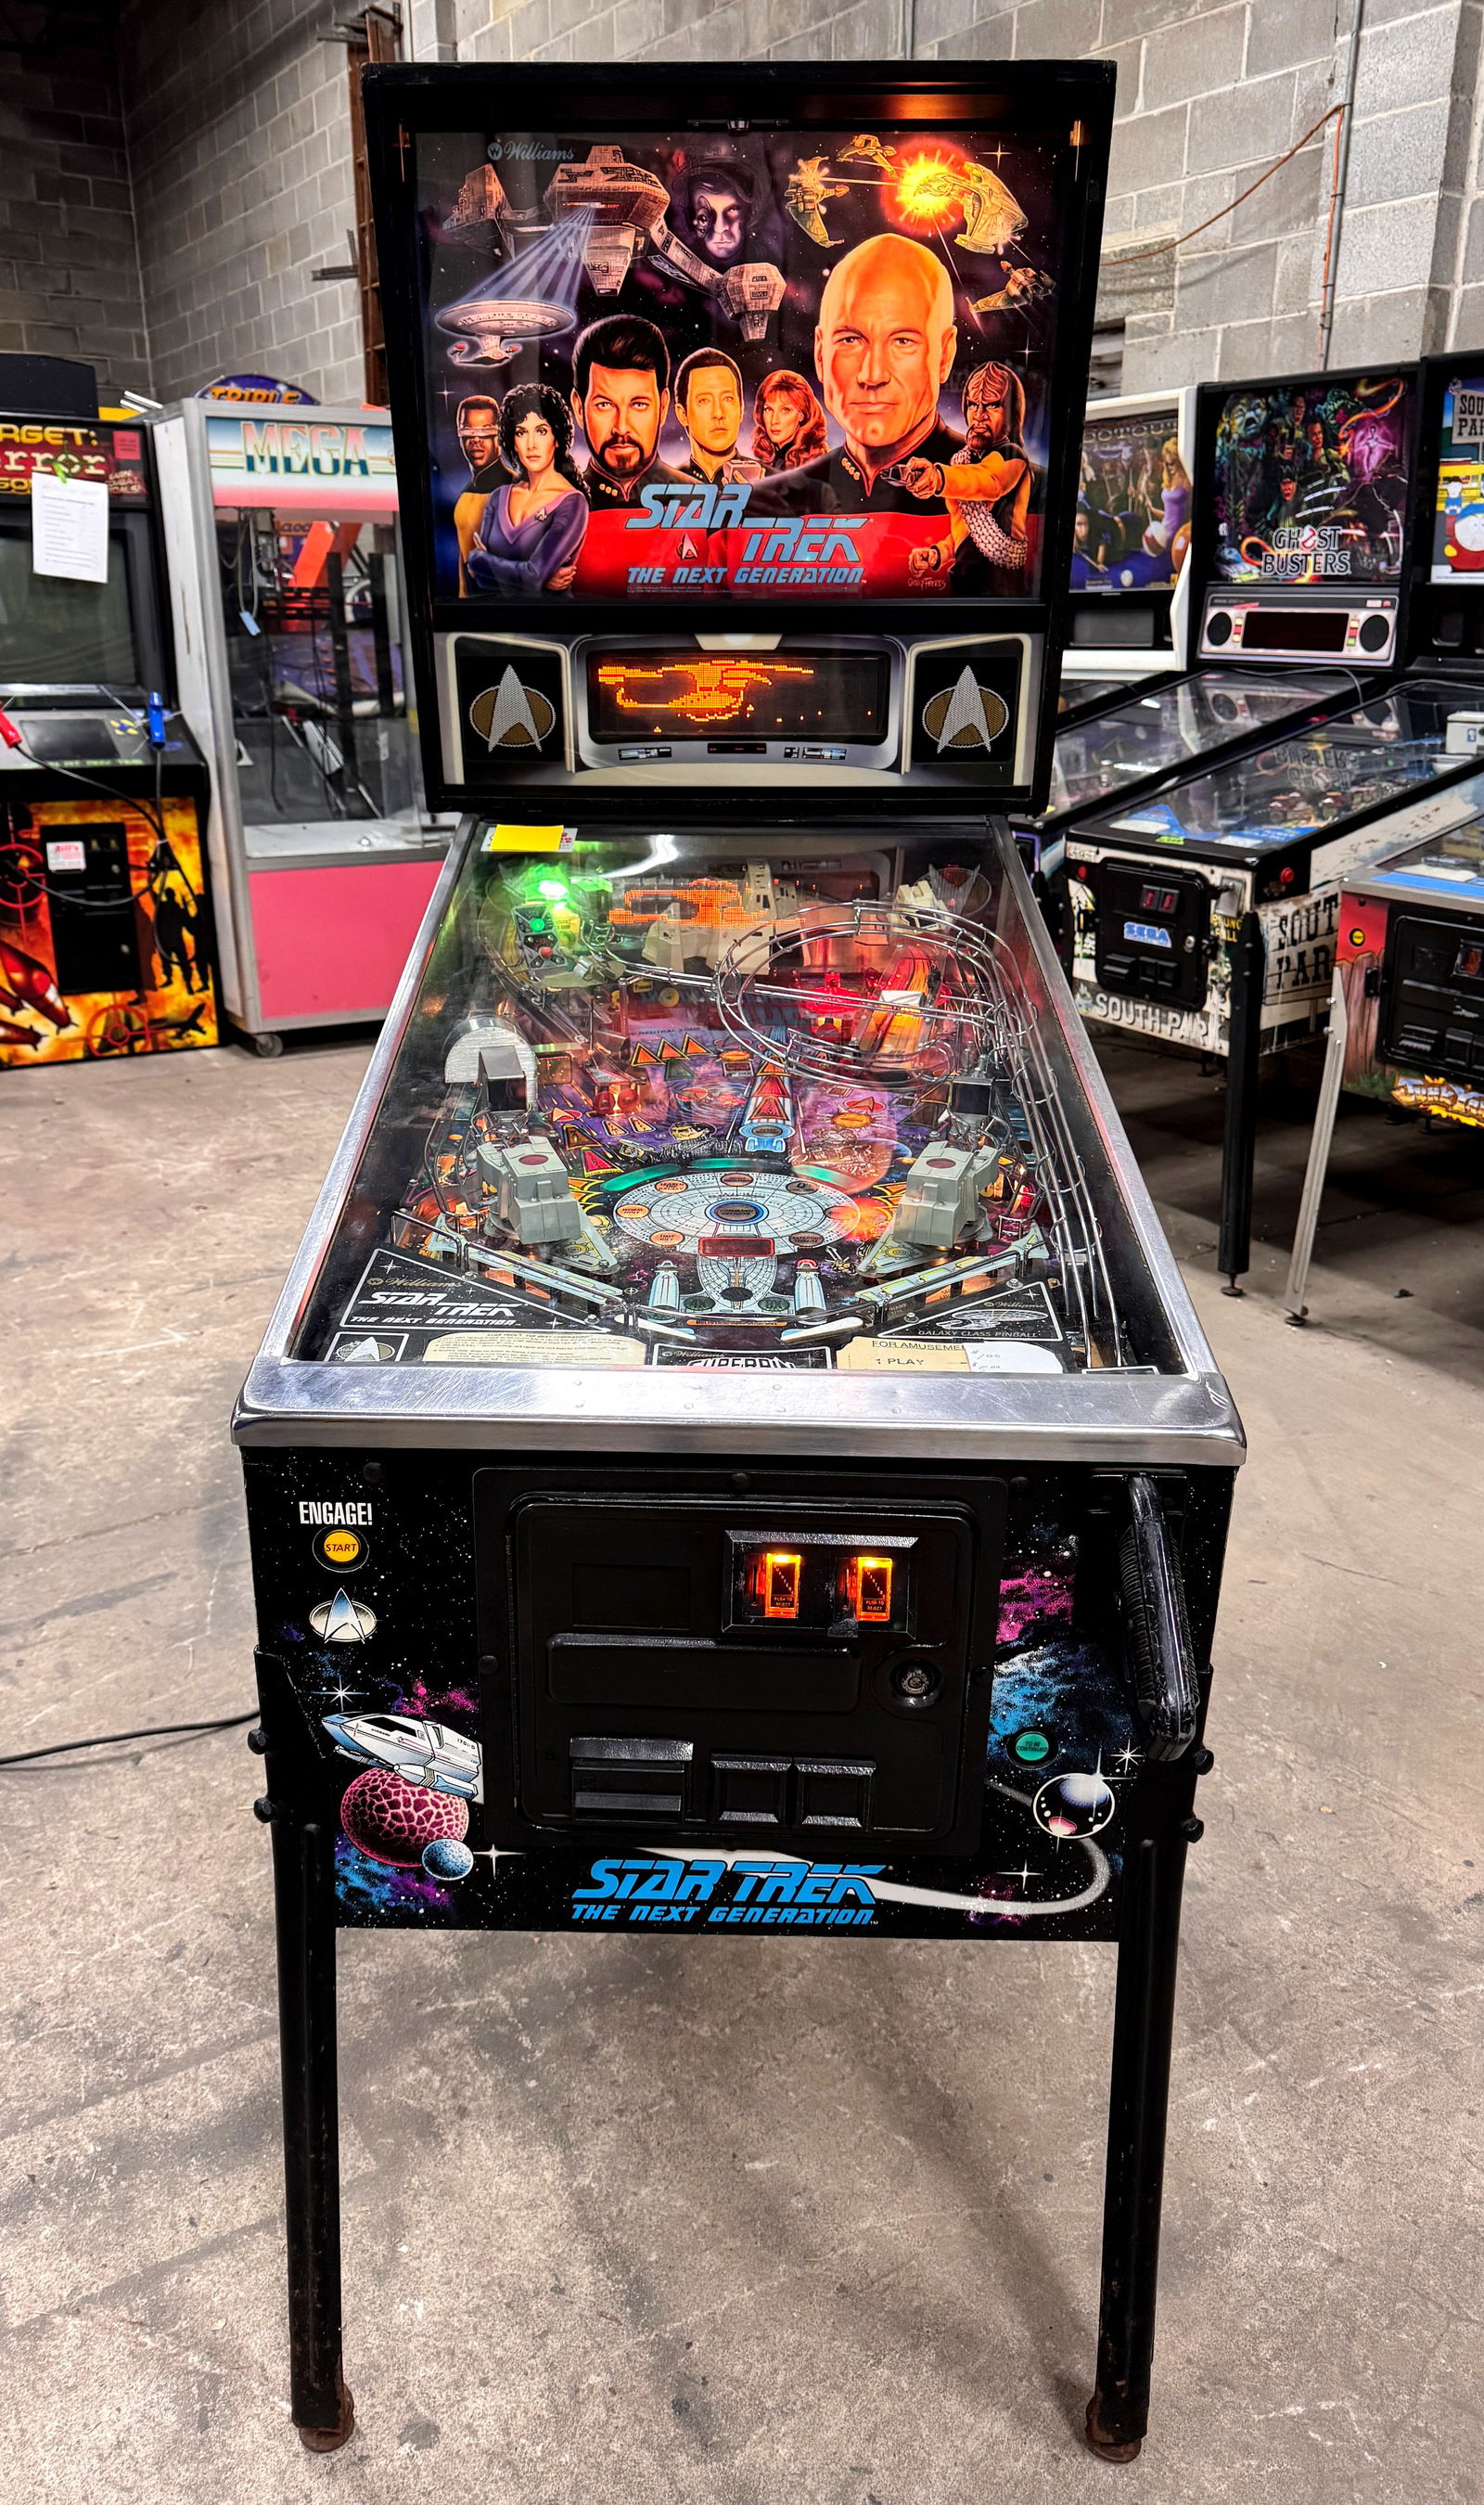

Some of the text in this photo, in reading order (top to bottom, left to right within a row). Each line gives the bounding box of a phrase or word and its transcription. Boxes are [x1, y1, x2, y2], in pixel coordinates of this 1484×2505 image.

[504, 140, 575, 161] Williams
[241, 420, 370, 477] MEGA
[625, 482, 753, 530] STAR
[739, 517, 870, 563] TREK
[1272, 524, 1342, 551] GHOST
[1260, 550, 1352, 576] BUSTERS
[627, 567, 864, 584] THE NEXT GENERATION
[1124, 922, 1171, 944] SEGA
[385, 1278, 463, 1288] Williams
[358, 1291, 448, 1305] STAR
[994, 1301, 1045, 1309] Williams
[433, 1302, 523, 1317] TREK
[299, 1501, 373, 1526] ENGAGE!
[326, 1543, 357, 1552] START
[571, 1859, 728, 1899] STAR
[732, 1861, 888, 1905] TREK
[571, 1904, 876, 1925] THE NEXT GENERATION
